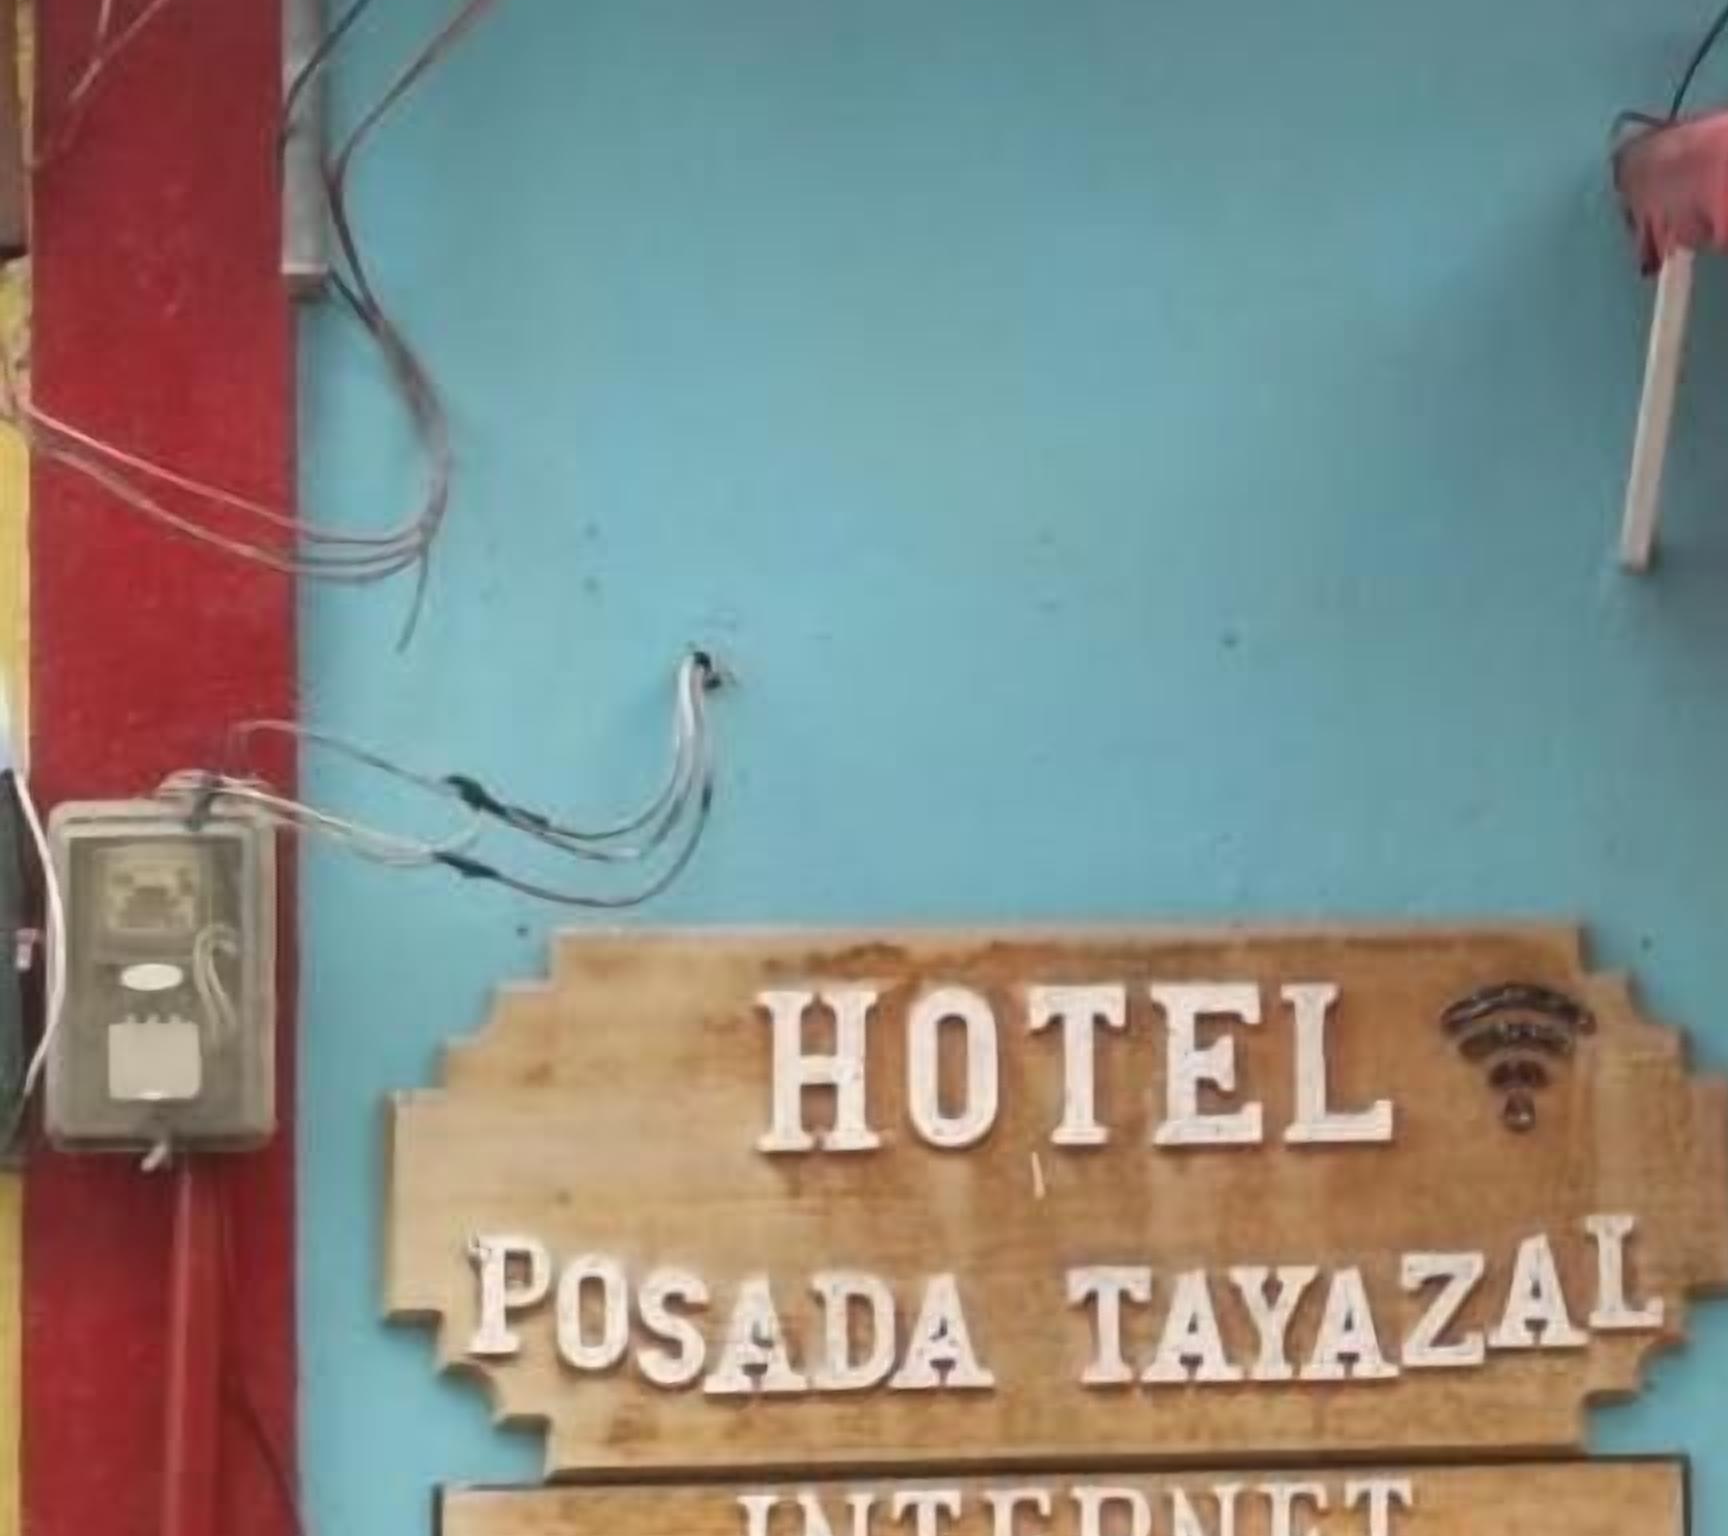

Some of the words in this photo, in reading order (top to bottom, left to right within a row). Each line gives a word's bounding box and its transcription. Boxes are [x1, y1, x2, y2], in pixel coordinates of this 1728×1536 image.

[755, 980, 1394, 1154] HOTEL
[467, 1233, 996, 1396] POSADA
[1067, 1212, 1664, 1385] TAYAZAL
